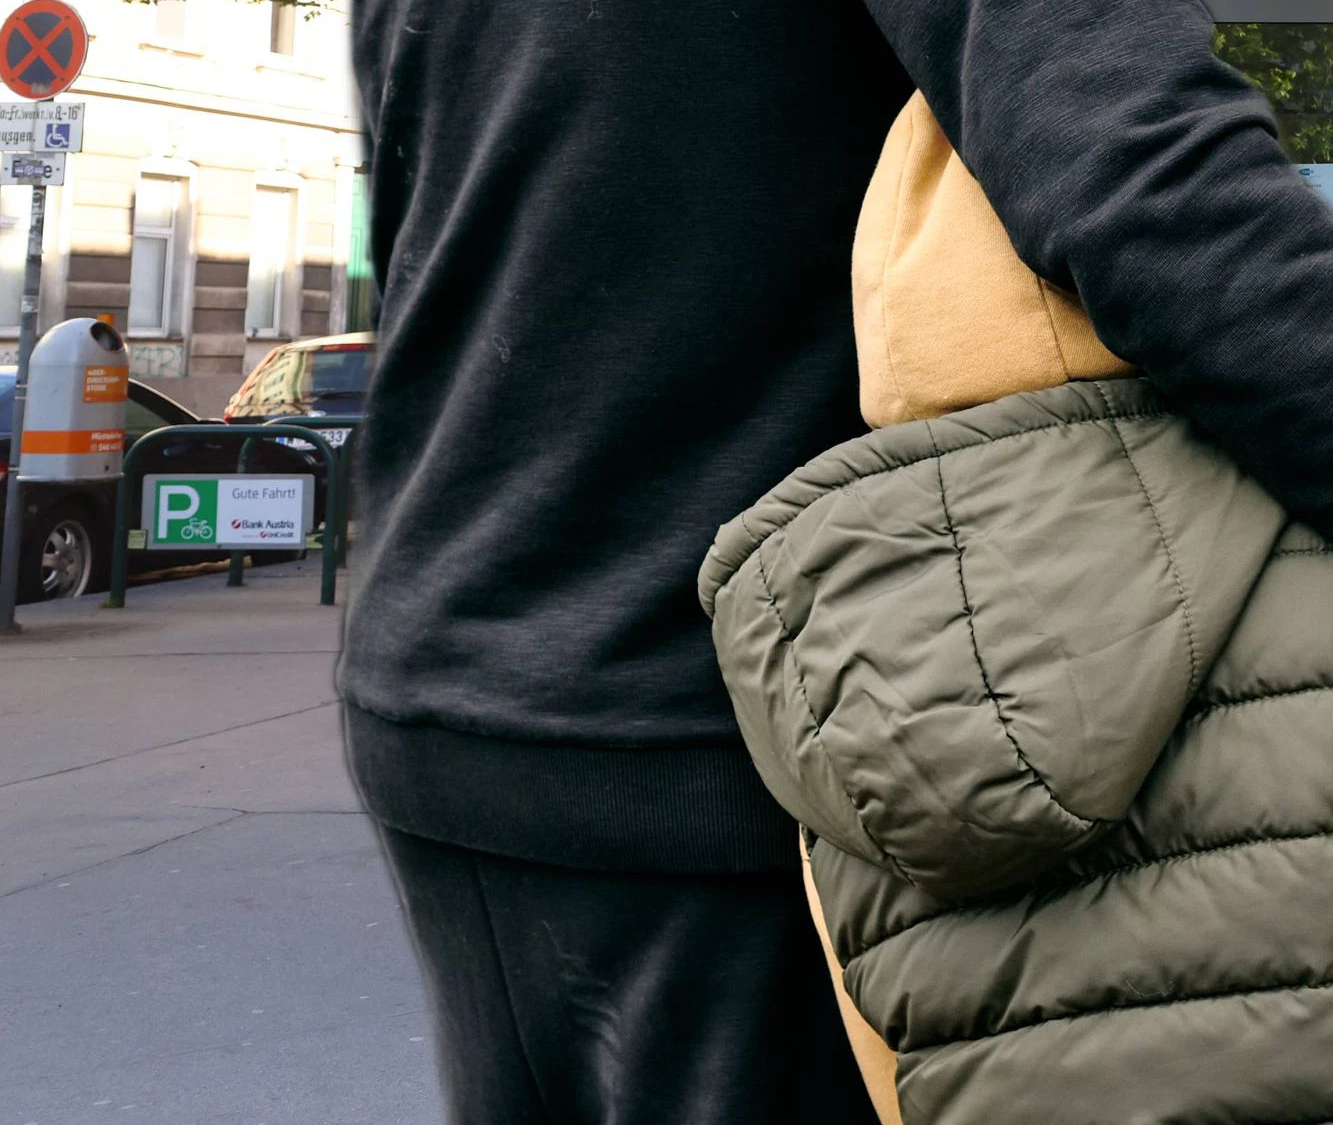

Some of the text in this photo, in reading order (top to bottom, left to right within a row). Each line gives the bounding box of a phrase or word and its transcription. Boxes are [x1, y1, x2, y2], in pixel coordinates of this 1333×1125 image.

[0, 130, 36, 145] usgen.
[232, 487, 296, 500] Gute Fahrt!
[242, 519, 294, 529] Bank Austria
